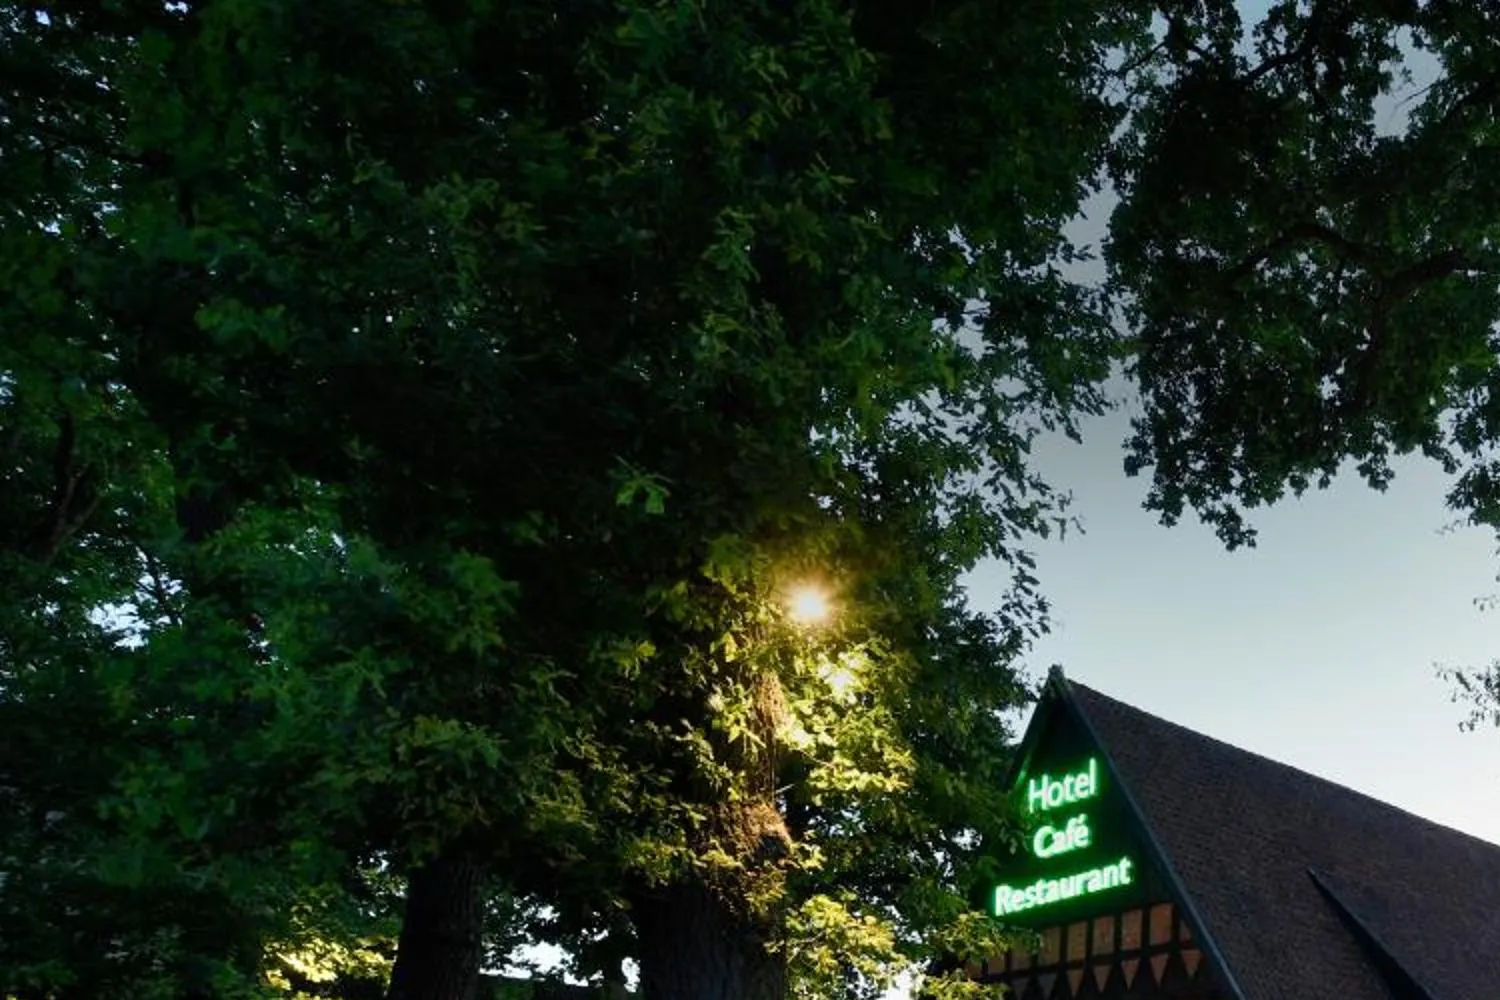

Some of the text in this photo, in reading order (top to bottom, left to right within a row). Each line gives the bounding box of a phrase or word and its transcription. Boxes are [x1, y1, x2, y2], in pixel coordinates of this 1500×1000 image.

[1028, 757, 1097, 813] Hotel
[1033, 813, 1089, 858] Café
[994, 856, 1132, 916] Restaurant
